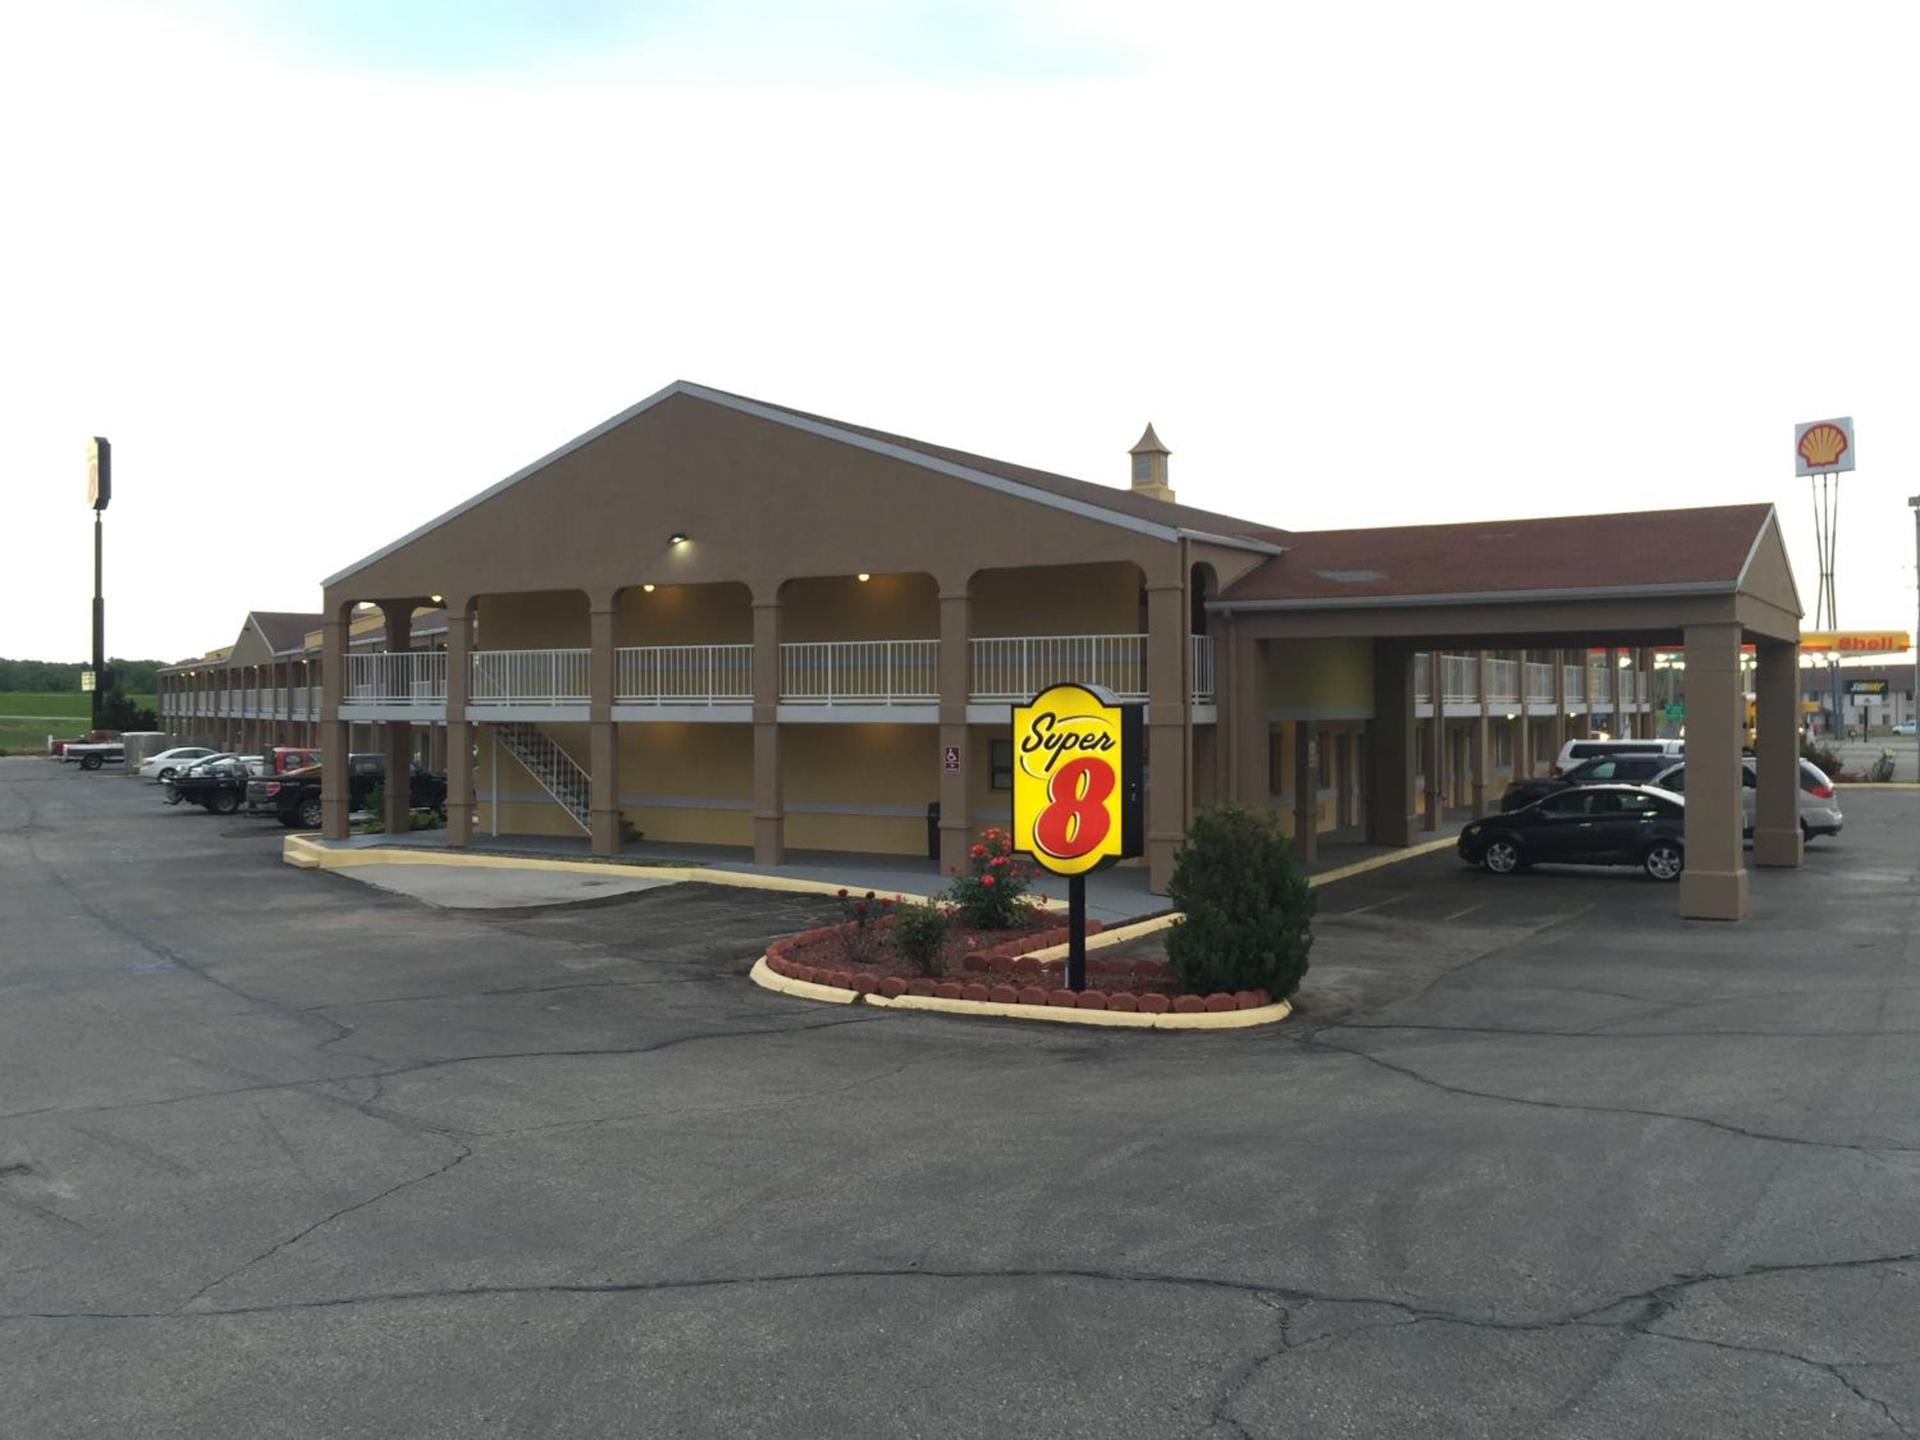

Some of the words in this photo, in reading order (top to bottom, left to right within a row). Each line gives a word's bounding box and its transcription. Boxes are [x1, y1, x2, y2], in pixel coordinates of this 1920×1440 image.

[1838, 637, 1893, 651] Shell
[1021, 711, 1116, 773] Super
[1033, 757, 1116, 860] 8
